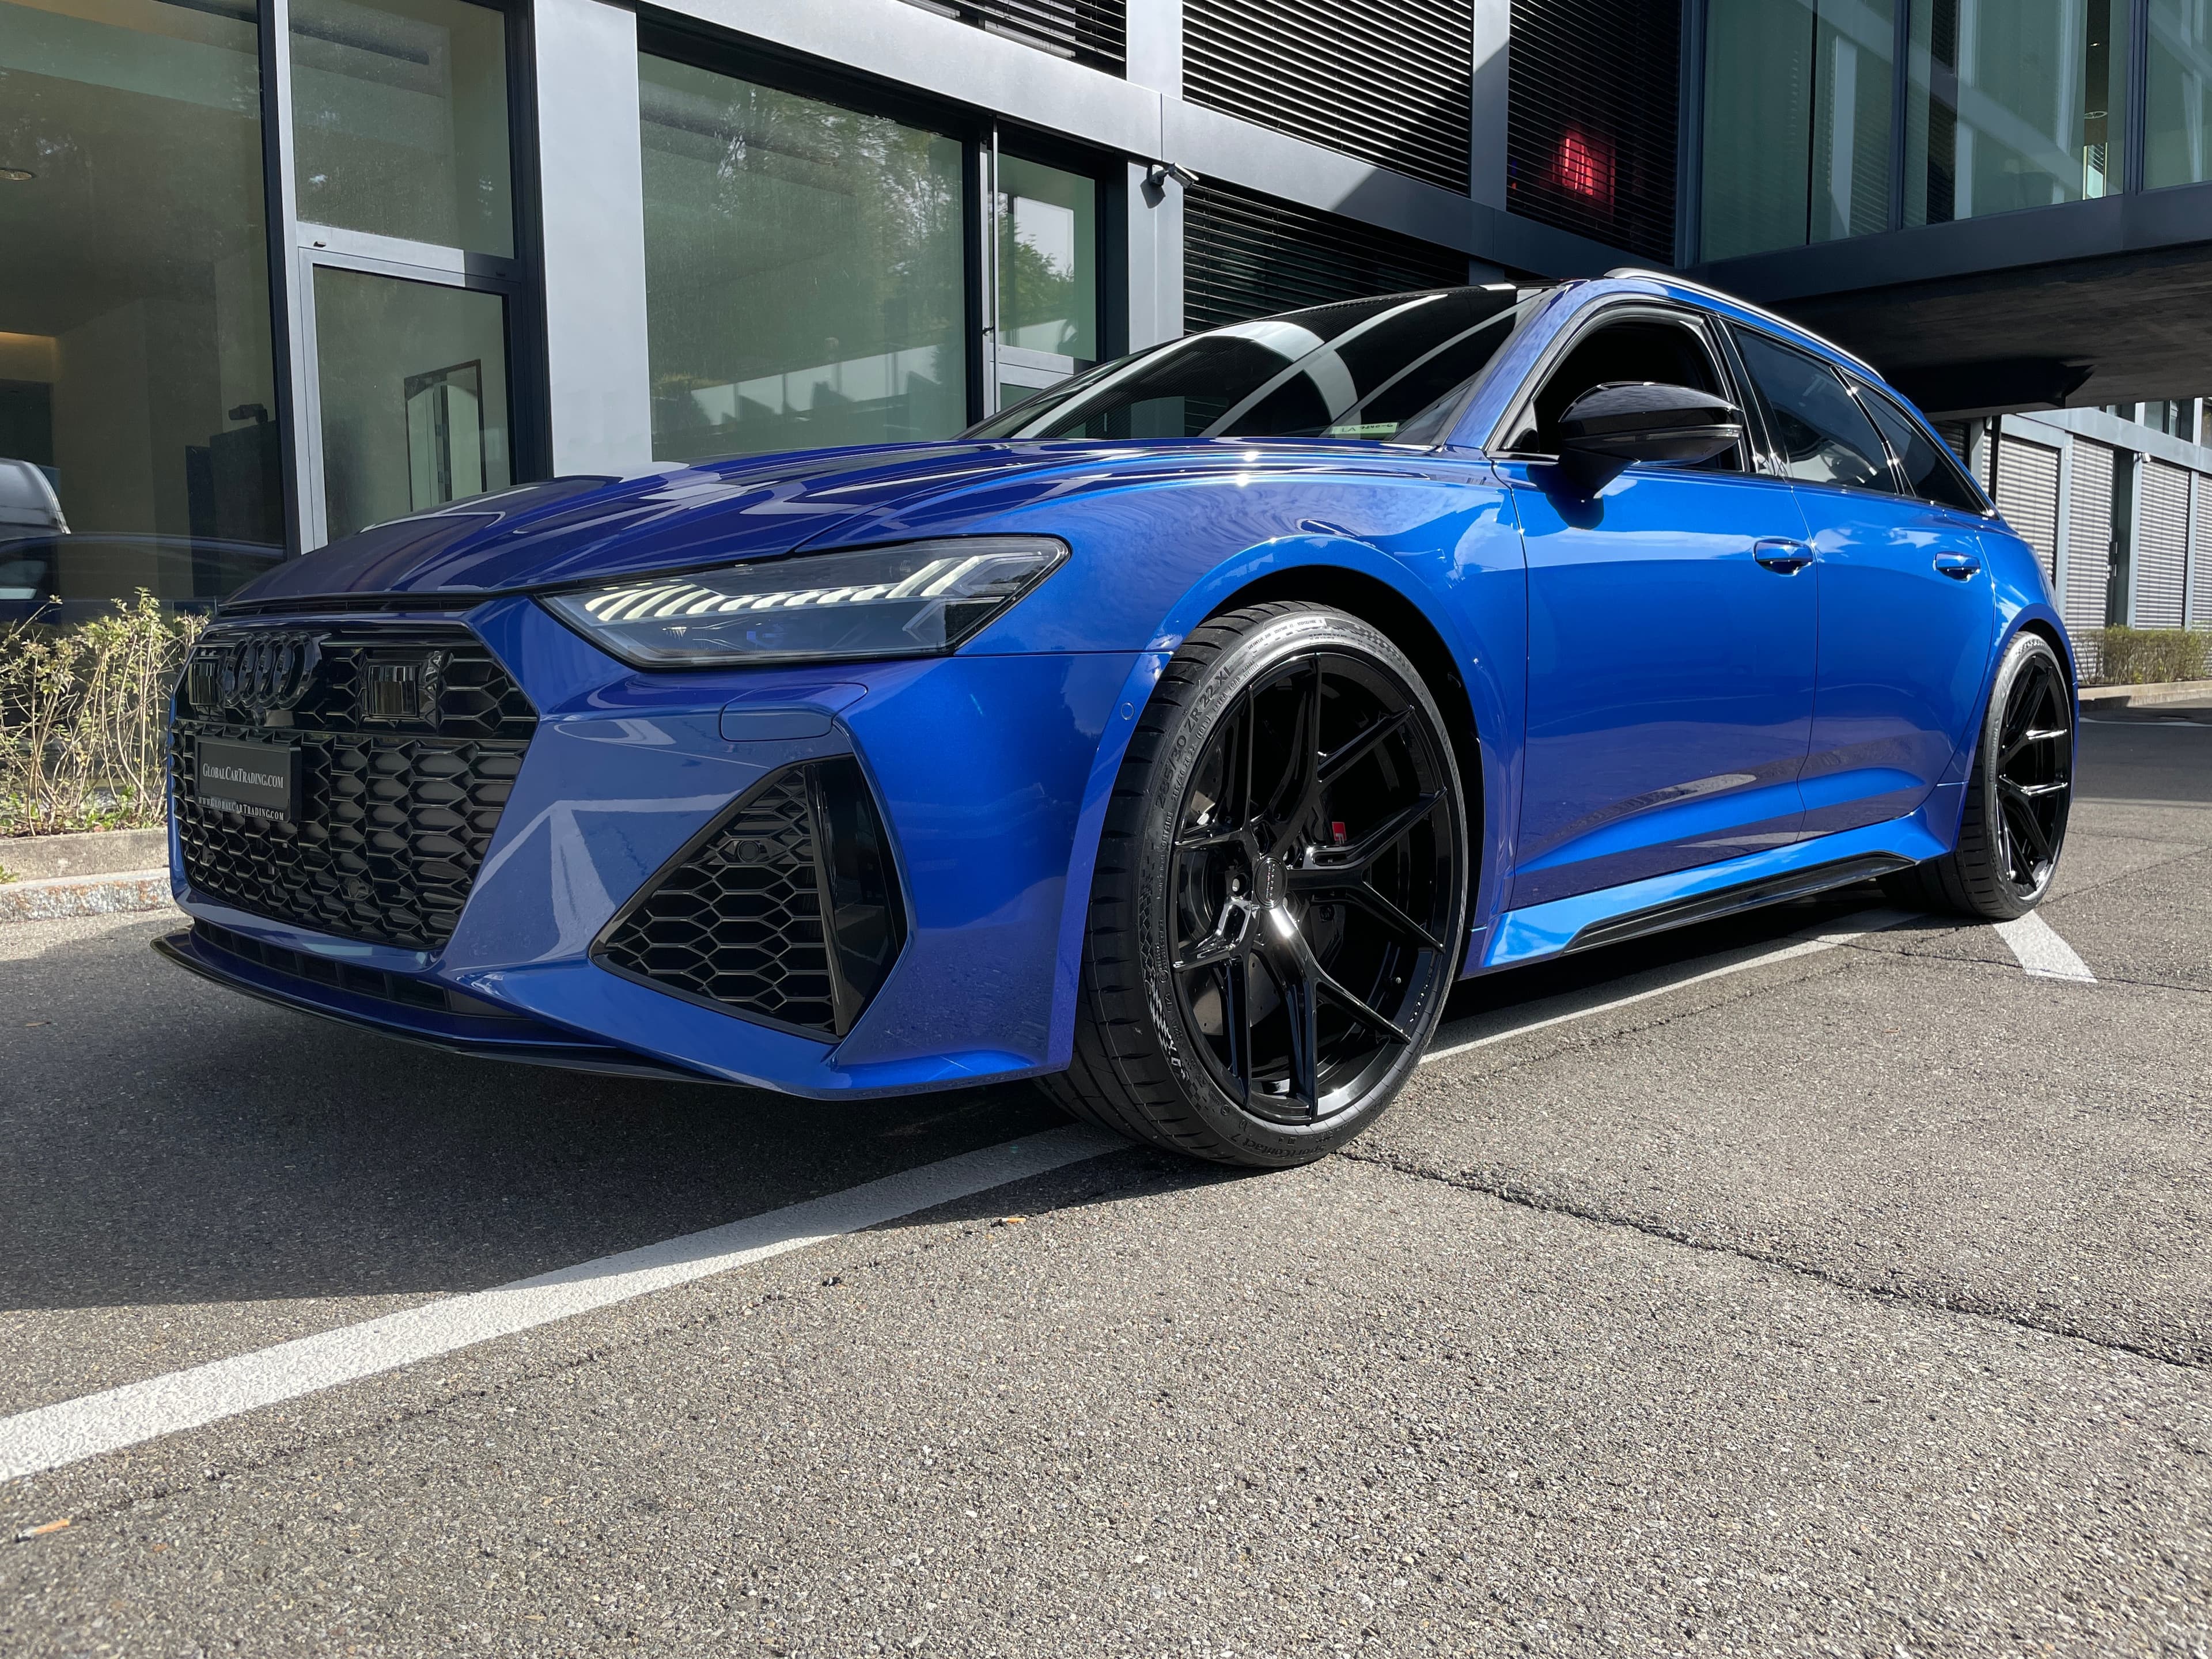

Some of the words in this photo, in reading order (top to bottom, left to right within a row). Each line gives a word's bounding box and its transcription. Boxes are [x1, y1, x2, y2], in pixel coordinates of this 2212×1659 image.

[1156, 735, 1187, 809] 285/30
[1184, 708, 1203, 733] ZR
[1199, 685, 1215, 709] 22
[1242, 1136, 1327, 1157] SportContact
